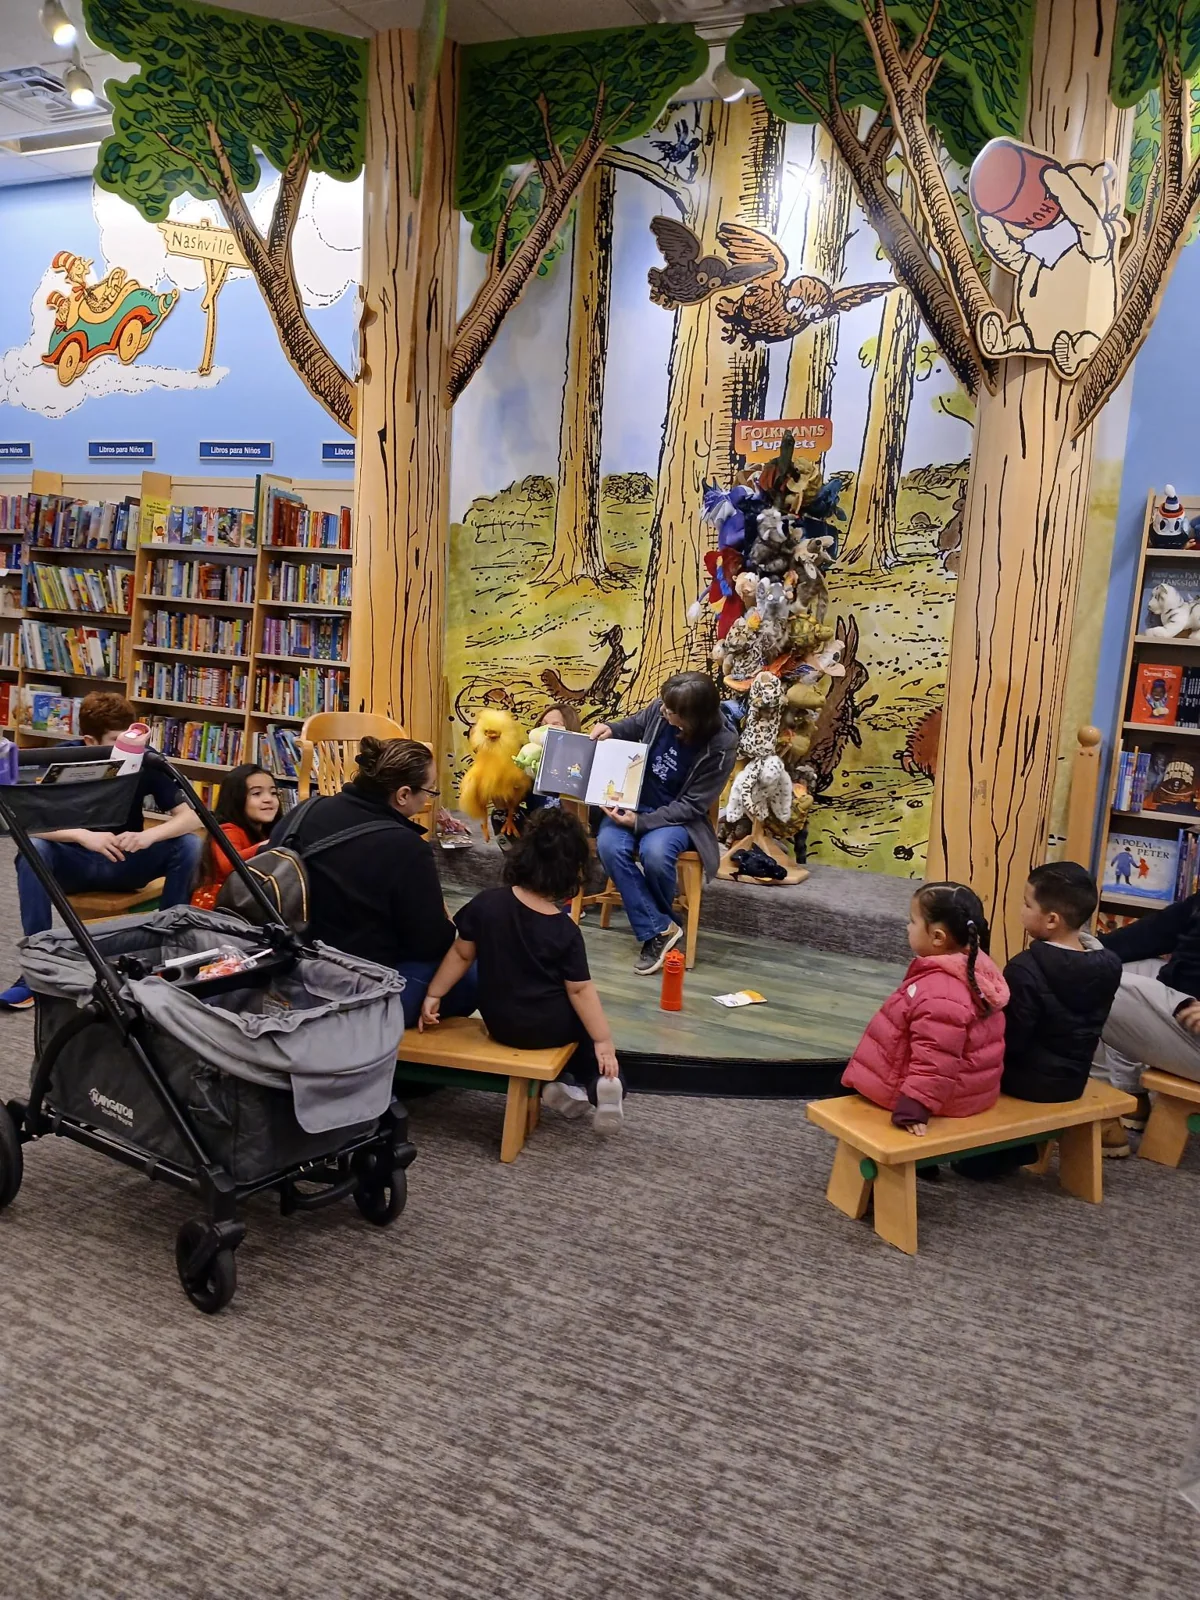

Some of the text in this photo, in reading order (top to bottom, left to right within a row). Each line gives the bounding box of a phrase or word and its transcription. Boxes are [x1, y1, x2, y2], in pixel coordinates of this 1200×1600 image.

[172, 231, 235, 255] Nashville
[210, 446, 228, 454] Libros
[244, 446, 261, 455] Niños
[751, 439, 816, 452] Pupets
[1122, 839, 1152, 849] POEM
[1137, 849, 1170, 859] PETER
